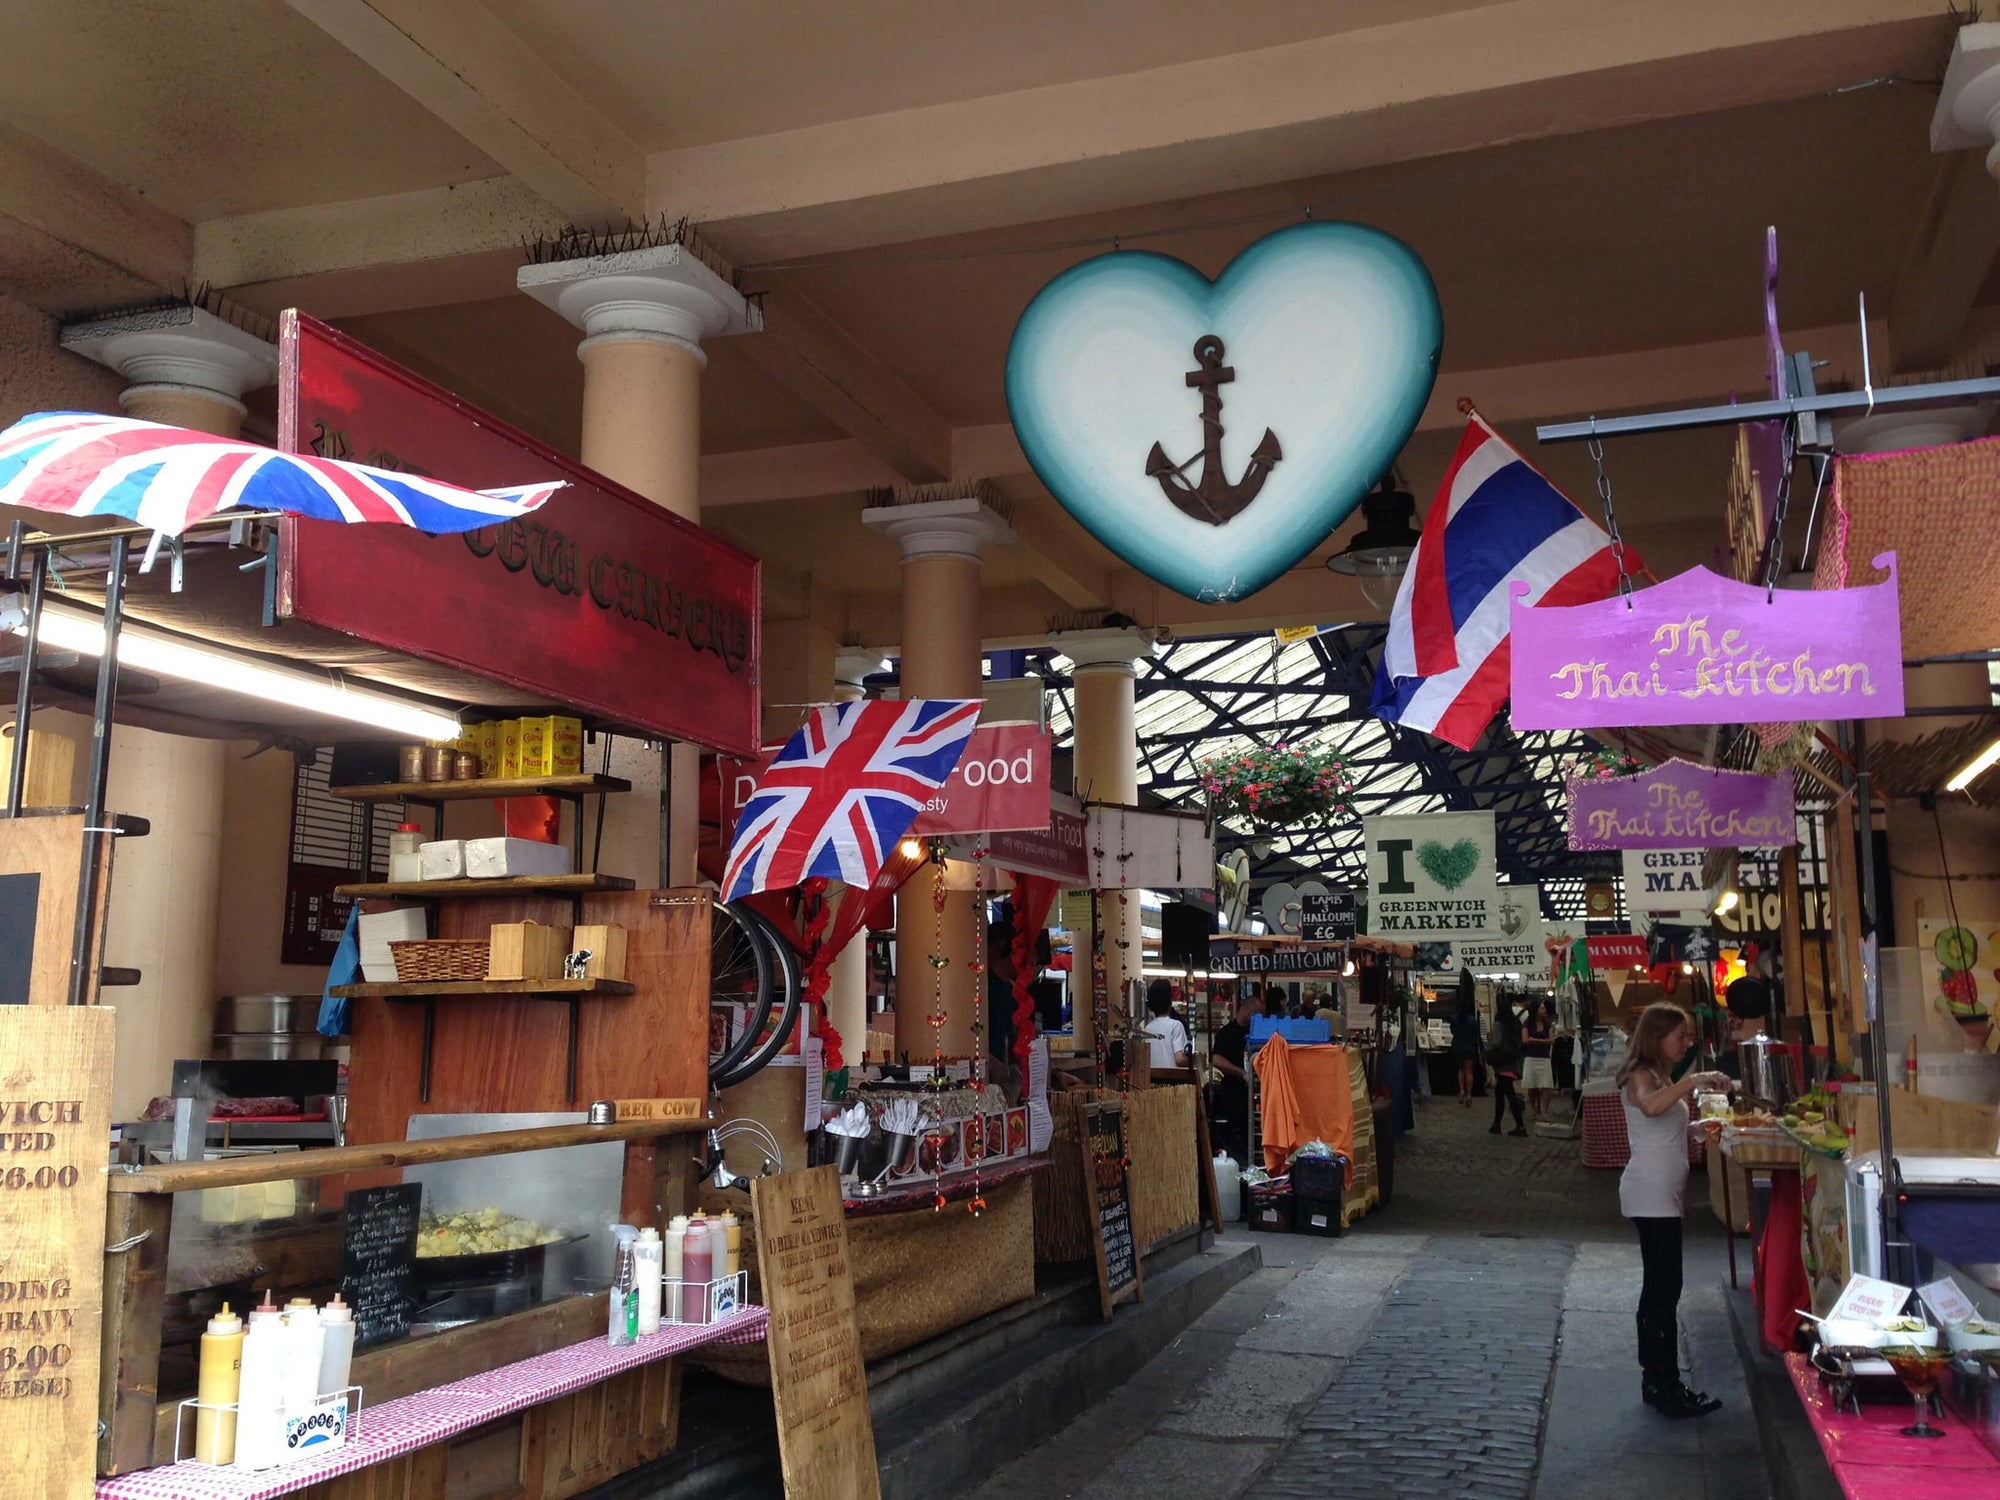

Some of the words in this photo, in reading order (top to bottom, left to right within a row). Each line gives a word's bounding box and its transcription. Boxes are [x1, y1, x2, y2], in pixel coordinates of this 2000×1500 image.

[1650, 613, 1748, 657] The
[1549, 656, 1670, 700] Thai
[941, 749, 1033, 788] ood
[1648, 782, 1703, 809] The
[921, 797, 949, 814] sty
[1588, 809, 1656, 840] Thai
[1377, 839, 1415, 894] I
[1311, 896, 1343, 904] LAMB
[1379, 900, 1486, 913] GREENWICH
[1303, 912, 1354, 923] HALLOUMI
[1380, 914, 1487, 930] MARKET
[1314, 926, 1335, 939] £6
[1461, 945, 1535, 955] GREENWICH
[1589, 945, 1642, 956] MAMMA
[1210, 954, 1270, 972] GRILLED
[1462, 954, 1536, 967] MARKET
[619, 1102, 651, 1118] RED
[662, 1101, 697, 1117] COW
[0, 1164, 79, 1188] 6.00
